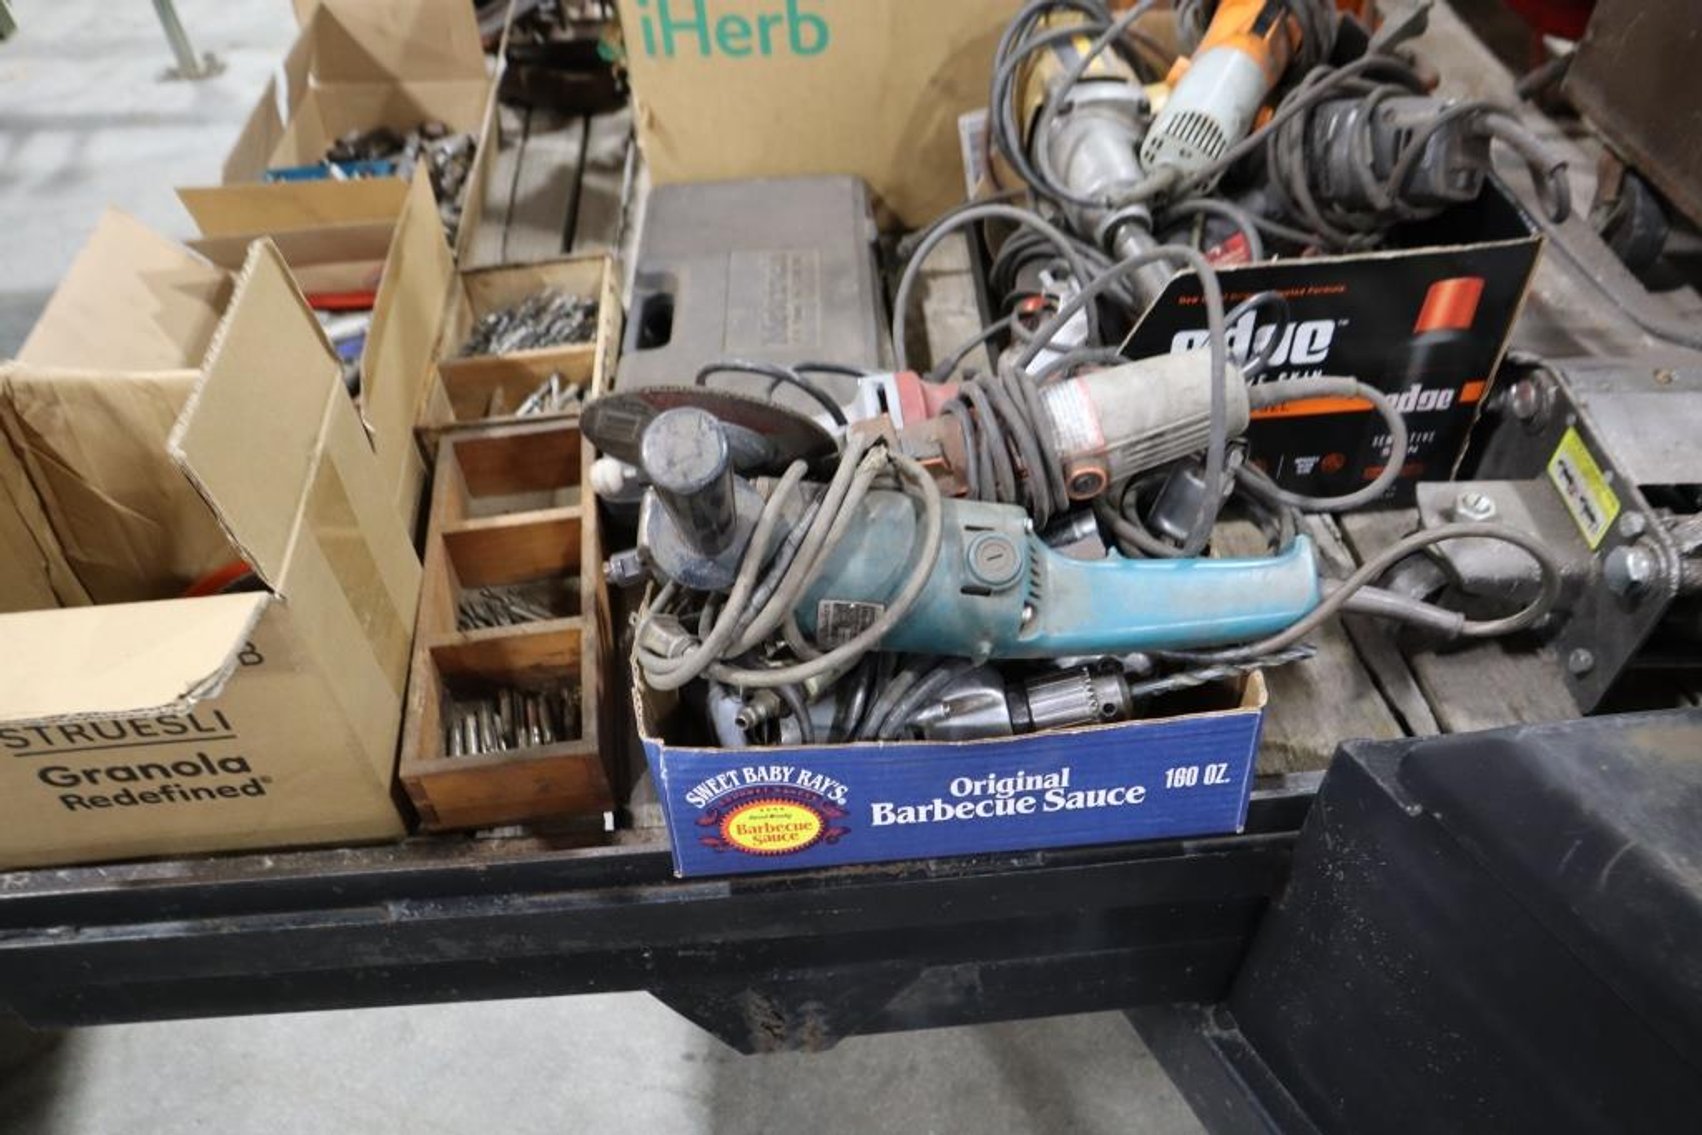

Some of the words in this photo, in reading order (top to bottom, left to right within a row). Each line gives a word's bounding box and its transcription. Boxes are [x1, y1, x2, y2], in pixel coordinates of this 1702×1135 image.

[638, 0, 830, 58] iHerb
[0, 709, 232, 749] STRUESLI
[38, 752, 252, 788] Granola
[686, 769, 742, 809] SWEET
[742, 765, 796, 784] BABY
[950, 767, 1070, 799] Original
[1203, 762, 1231, 786] OZ.
[871, 796, 1036, 826] Barbecue
[1042, 784, 1147, 813] Sauce
[736, 820, 813, 837] Barbecue
[752, 830, 801, 846] Sauce
